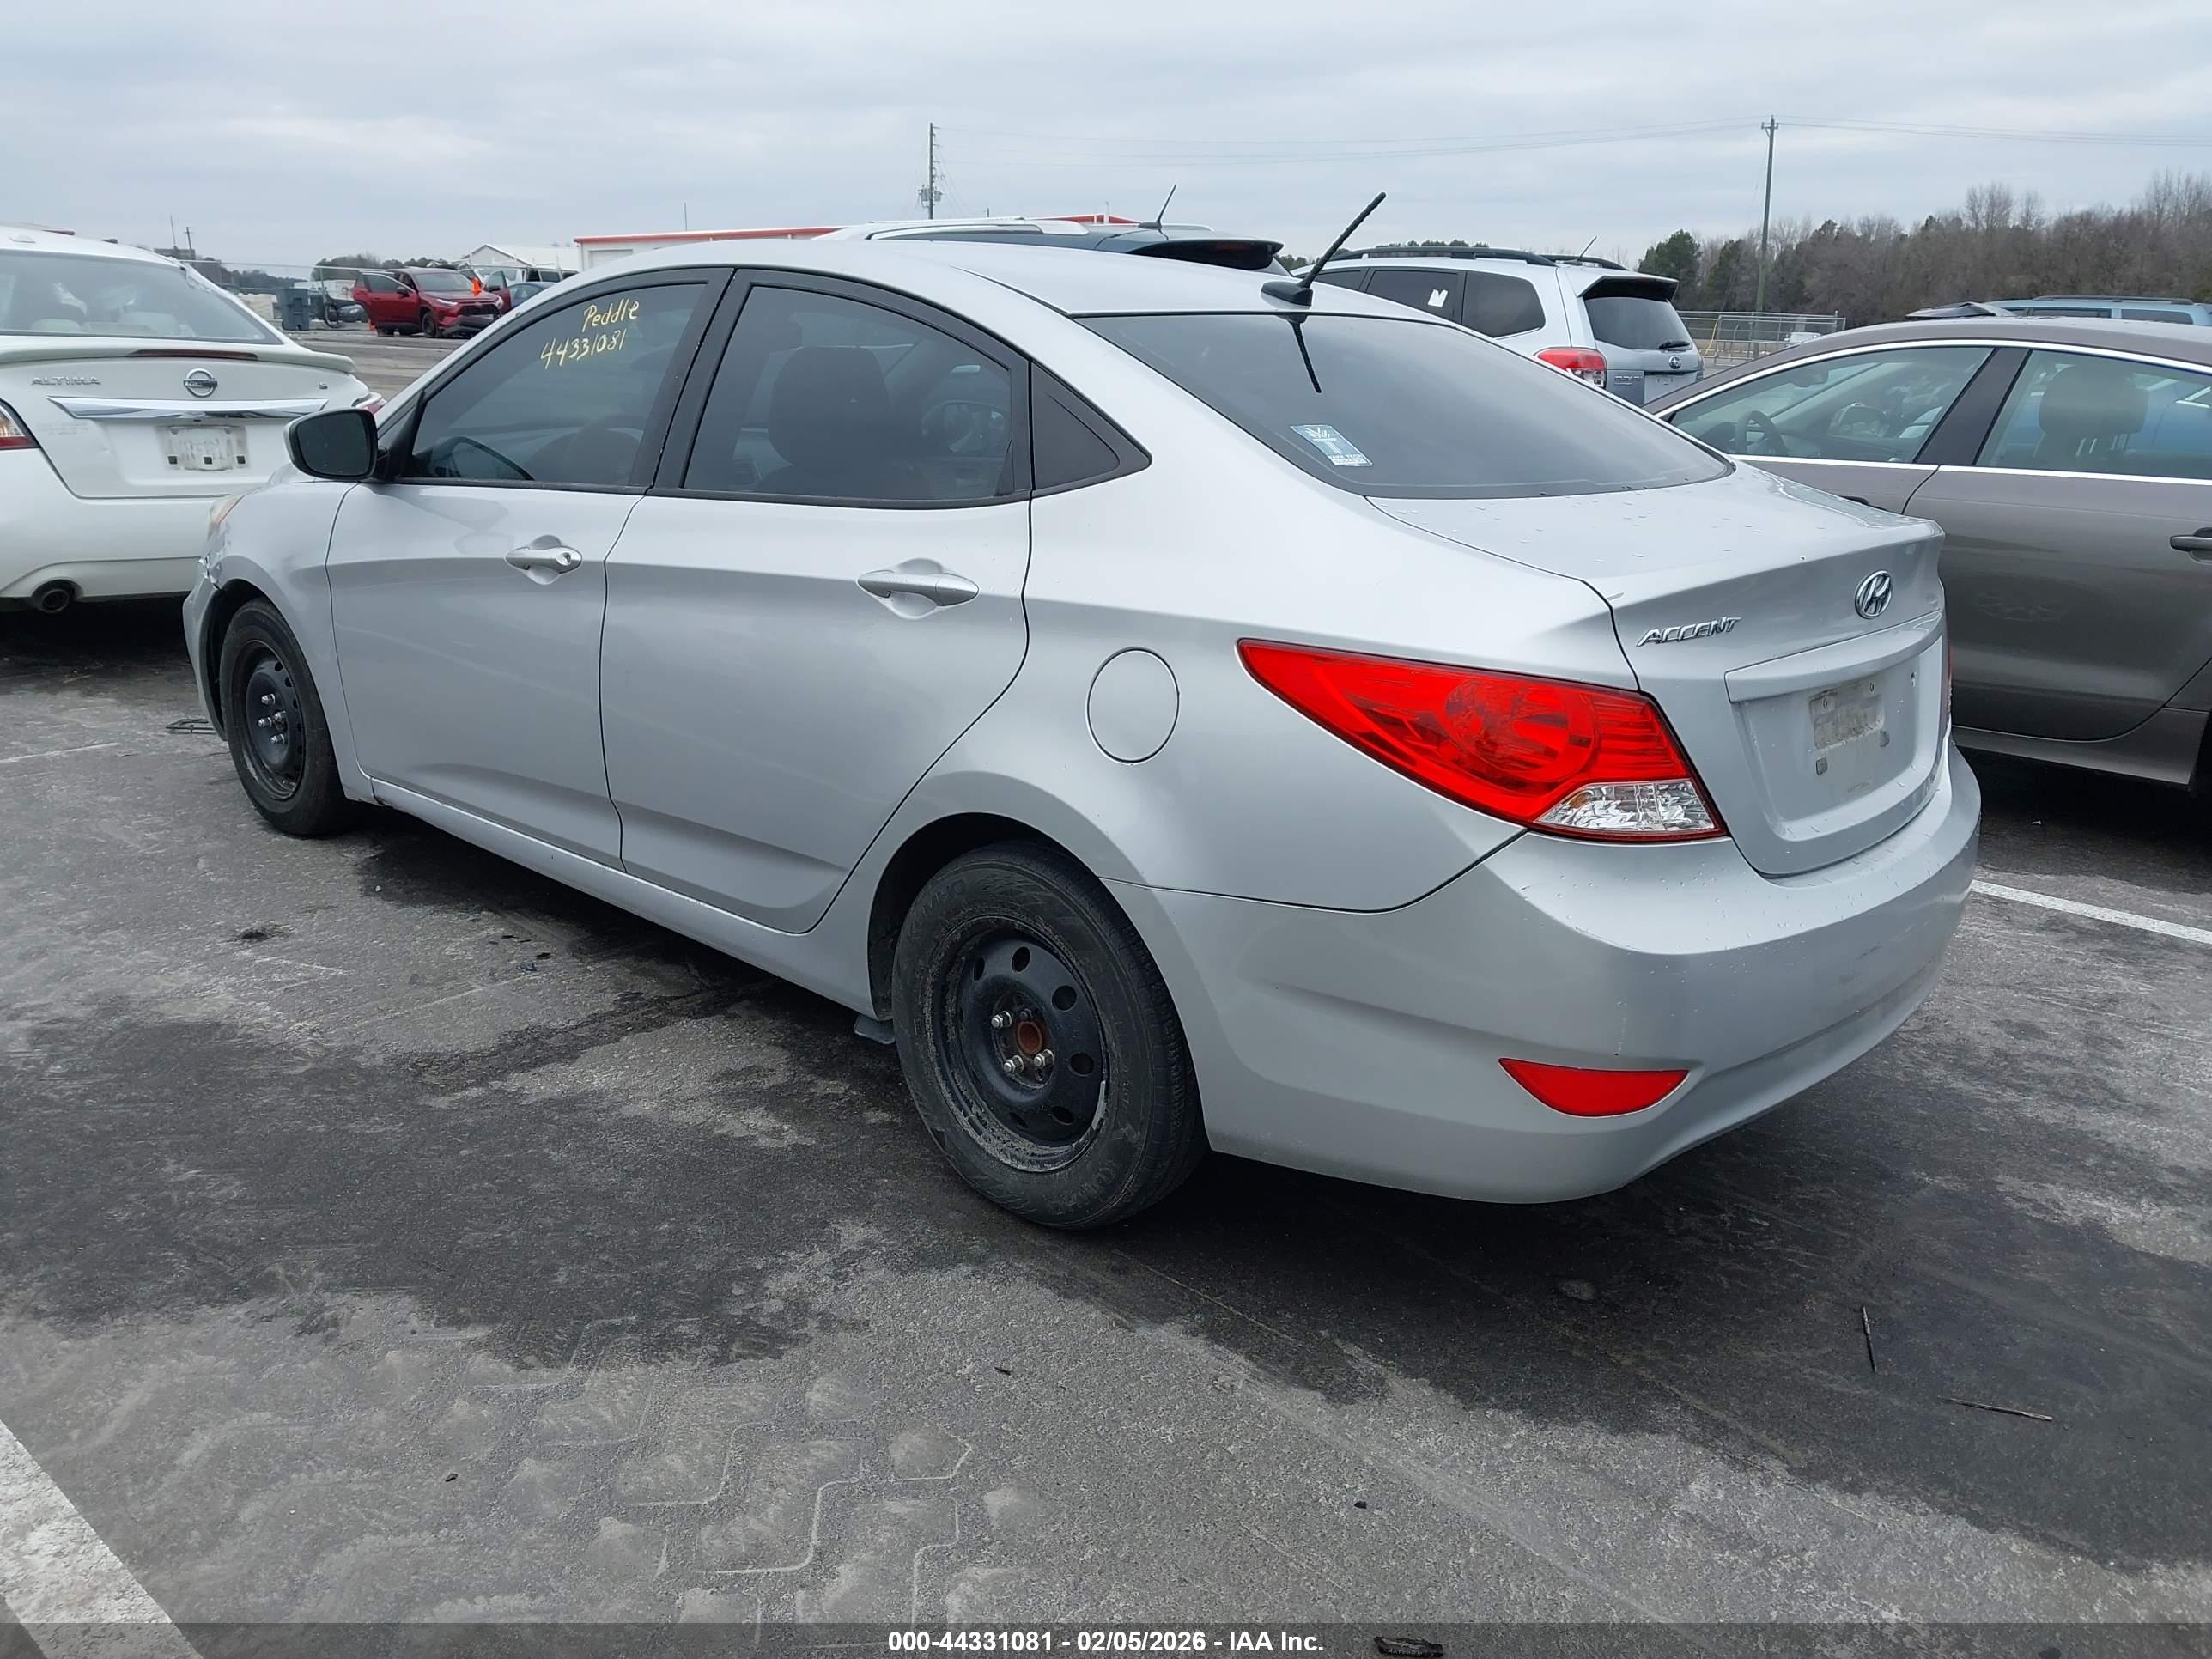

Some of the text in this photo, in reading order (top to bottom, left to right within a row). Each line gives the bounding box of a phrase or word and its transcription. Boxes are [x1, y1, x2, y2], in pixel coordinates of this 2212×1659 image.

[582, 298, 640, 332] Peddle
[540, 328, 627, 369] 44331081
[31, 375, 101, 386] ALTIMA
[1636, 617, 1742, 647] ACCENT
